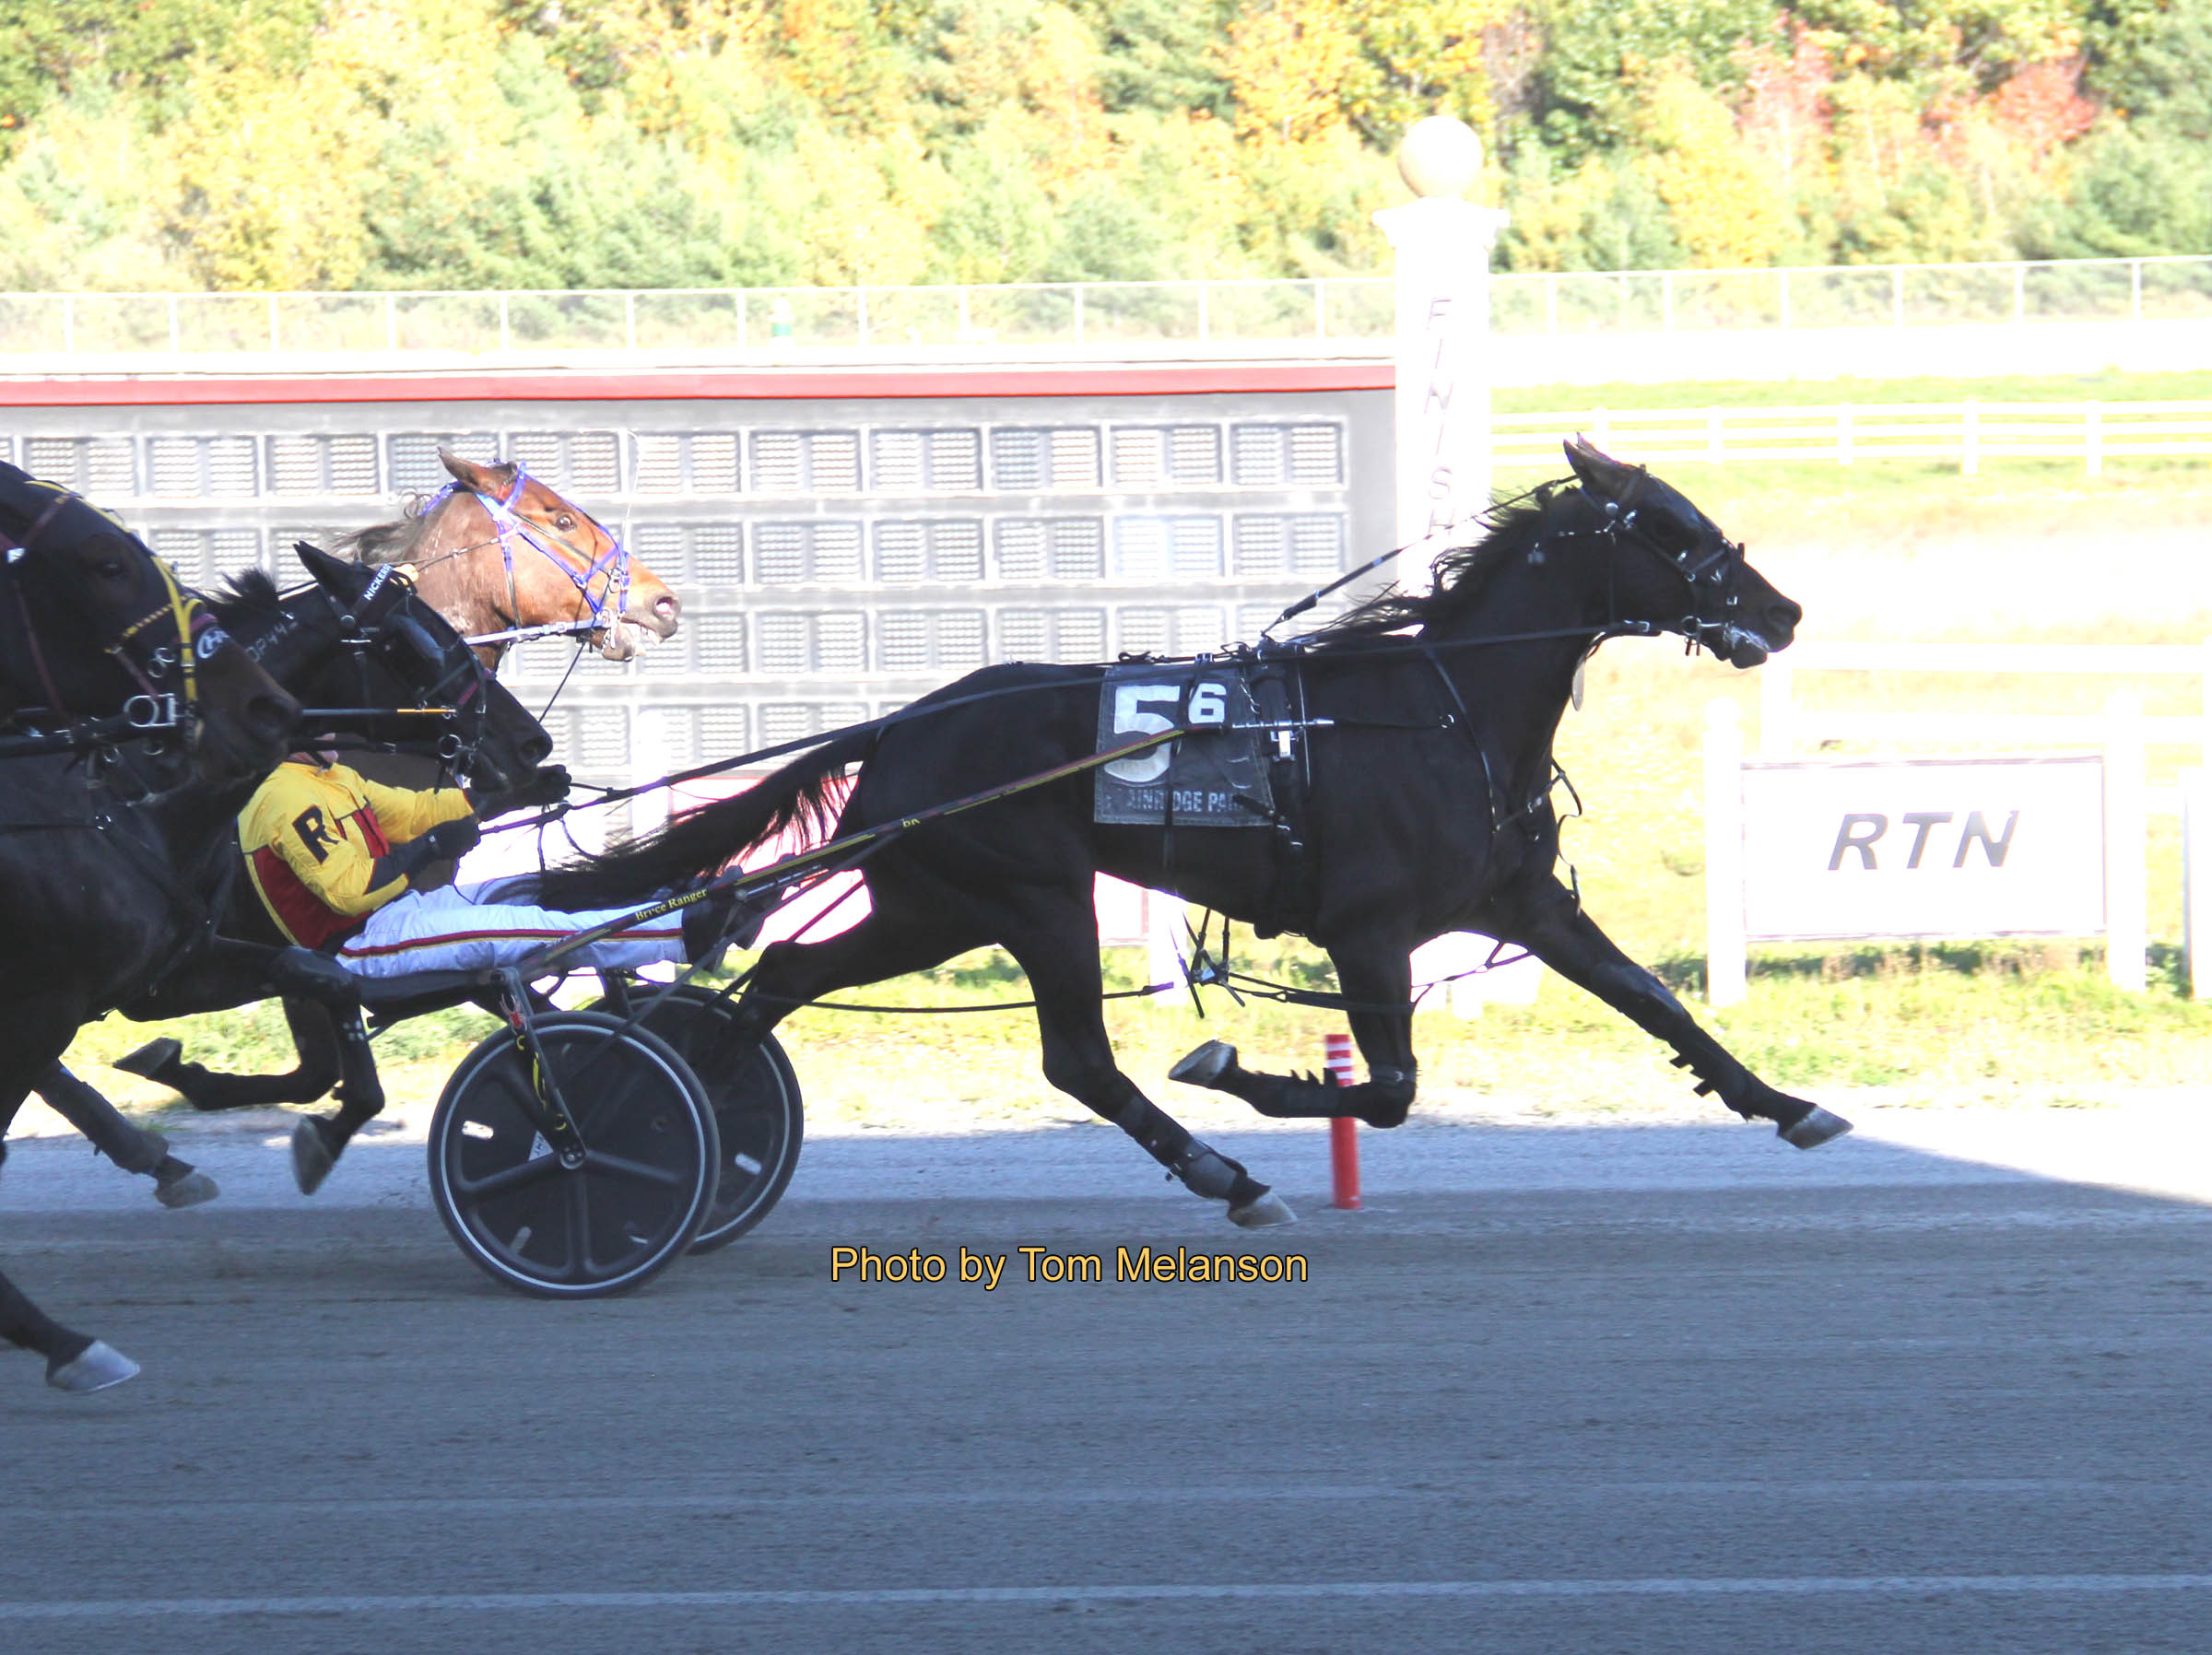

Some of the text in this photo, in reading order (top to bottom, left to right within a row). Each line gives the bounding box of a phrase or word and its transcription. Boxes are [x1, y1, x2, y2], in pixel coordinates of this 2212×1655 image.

[1423, 296, 1454, 536] FINISH
[1104, 684, 1181, 782] 5
[1188, 682, 1227, 724] 6
[291, 804, 340, 865] R
[1827, 810, 2020, 871] RTN
[667, 888, 708, 909] Ranger
